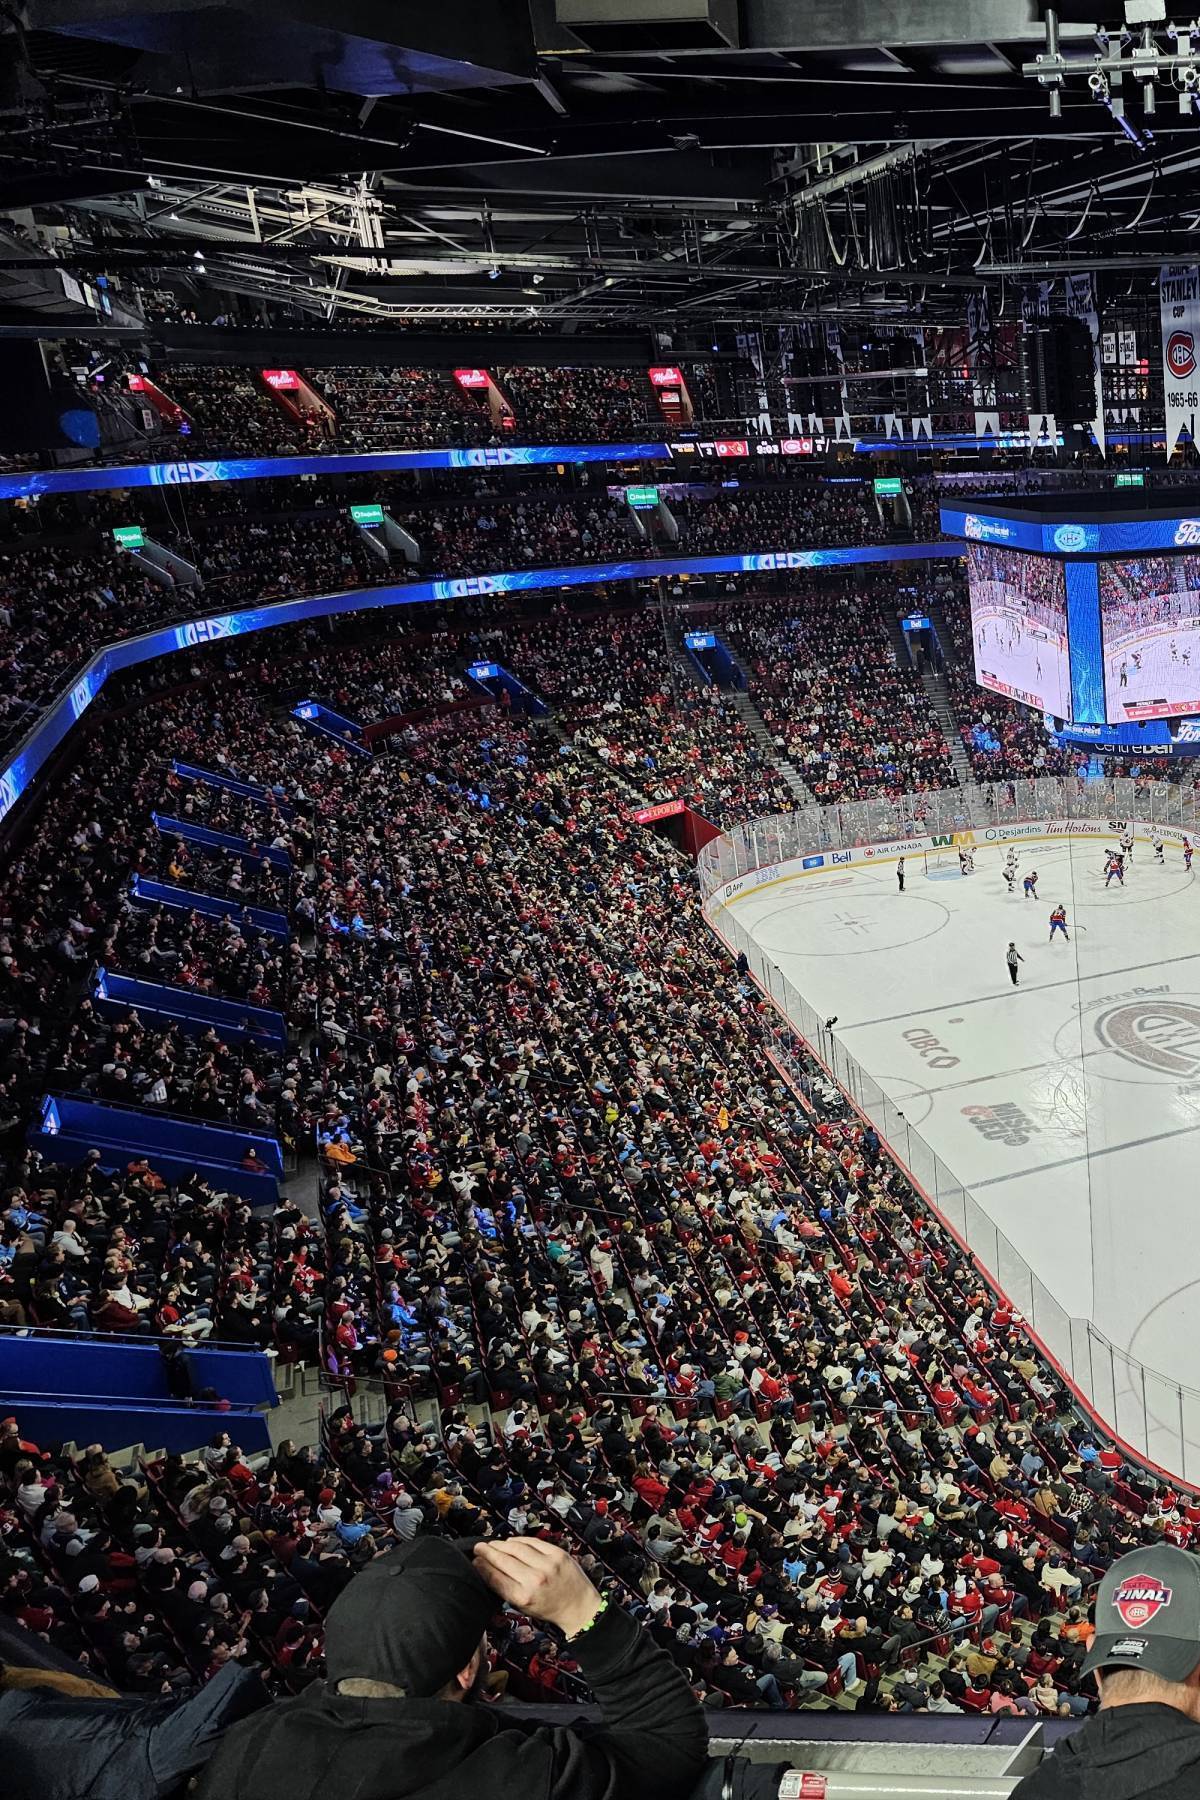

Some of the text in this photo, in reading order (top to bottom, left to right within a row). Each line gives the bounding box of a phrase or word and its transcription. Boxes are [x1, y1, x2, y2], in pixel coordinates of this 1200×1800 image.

[1162, 277, 1197, 303] STANLEY
[1173, 305, 1185, 318] CUP
[1167, 392, 1198, 407] 1965-66
[998, 825, 1042, 837] Desjardins
[1045, 821, 1101, 834] Tim Hortons
[1108, 821, 1127, 830] SN
[931, 831, 976, 847] WM
[891, 842, 922, 852] CANADA
[832, 851, 851, 864] Bell
[902, 1028, 949, 1058] CIBC
[1117, 1588, 1165, 1602] FINAL
